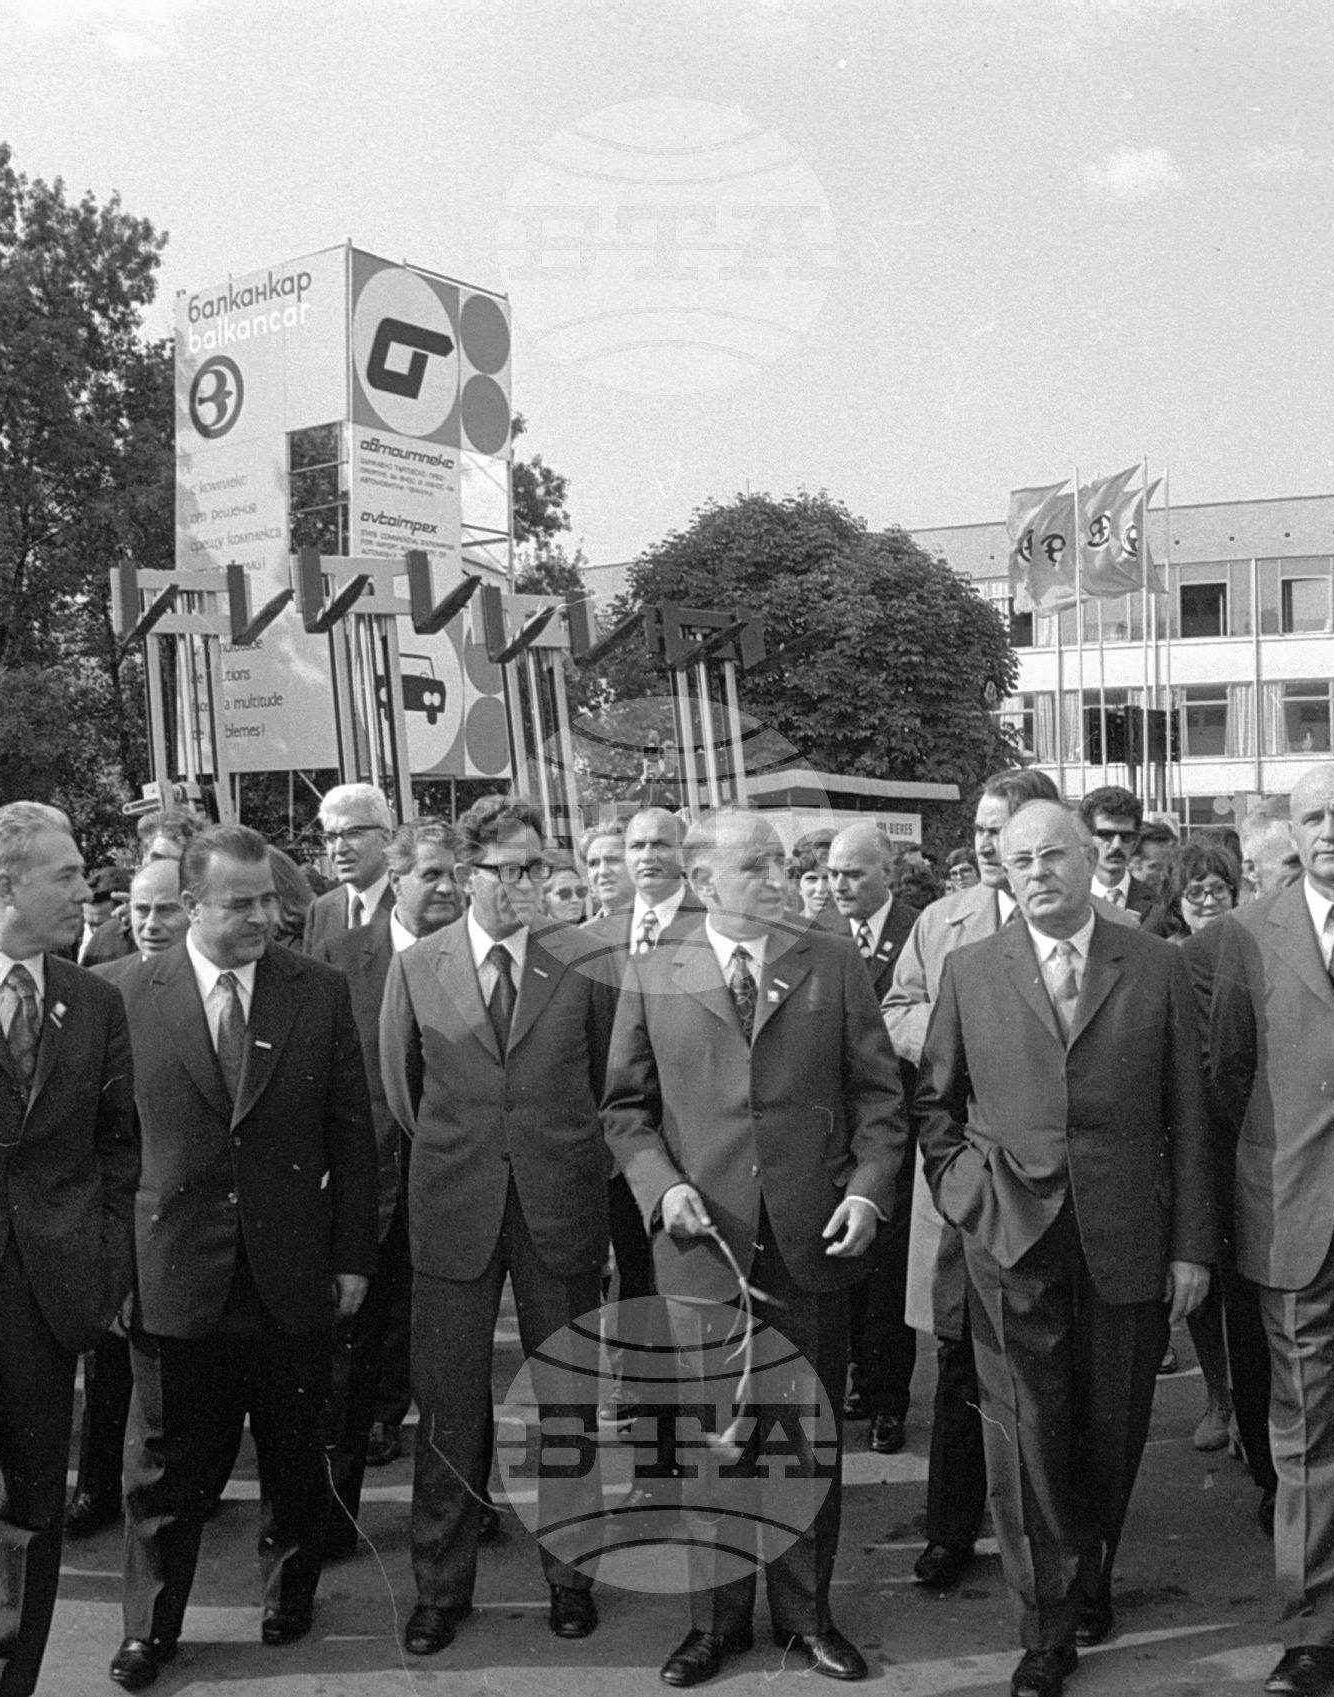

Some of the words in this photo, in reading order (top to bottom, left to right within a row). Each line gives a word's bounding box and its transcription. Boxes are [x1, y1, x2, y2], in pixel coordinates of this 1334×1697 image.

[188, 271, 312, 323] балканкар
[188, 303, 309, 353] balkancar
[360, 511, 438, 536] avtoimpex
[233, 690, 284, 709] multitude
